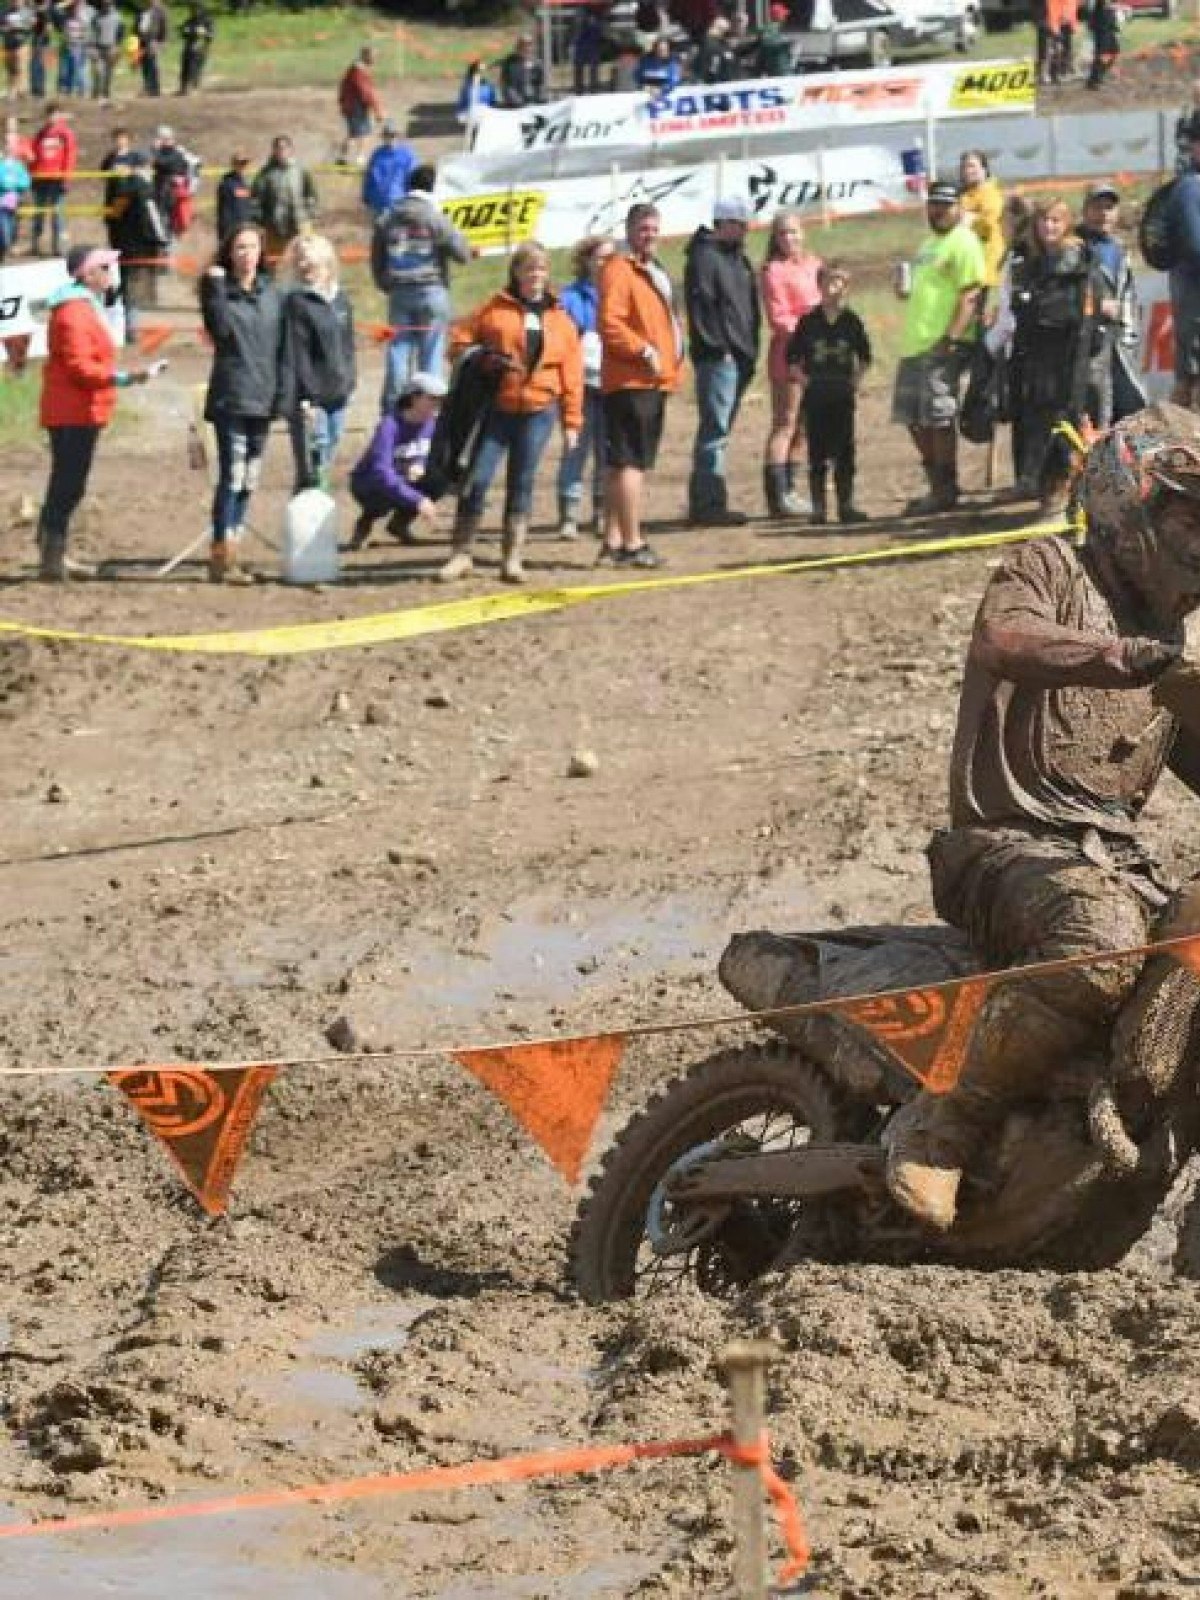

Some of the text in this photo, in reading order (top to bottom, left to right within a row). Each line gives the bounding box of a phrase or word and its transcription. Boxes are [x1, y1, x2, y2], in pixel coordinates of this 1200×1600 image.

[962, 67, 1035, 95] MOO
[645, 87, 788, 118] PARTS
[442, 196, 540, 230] OOSE
